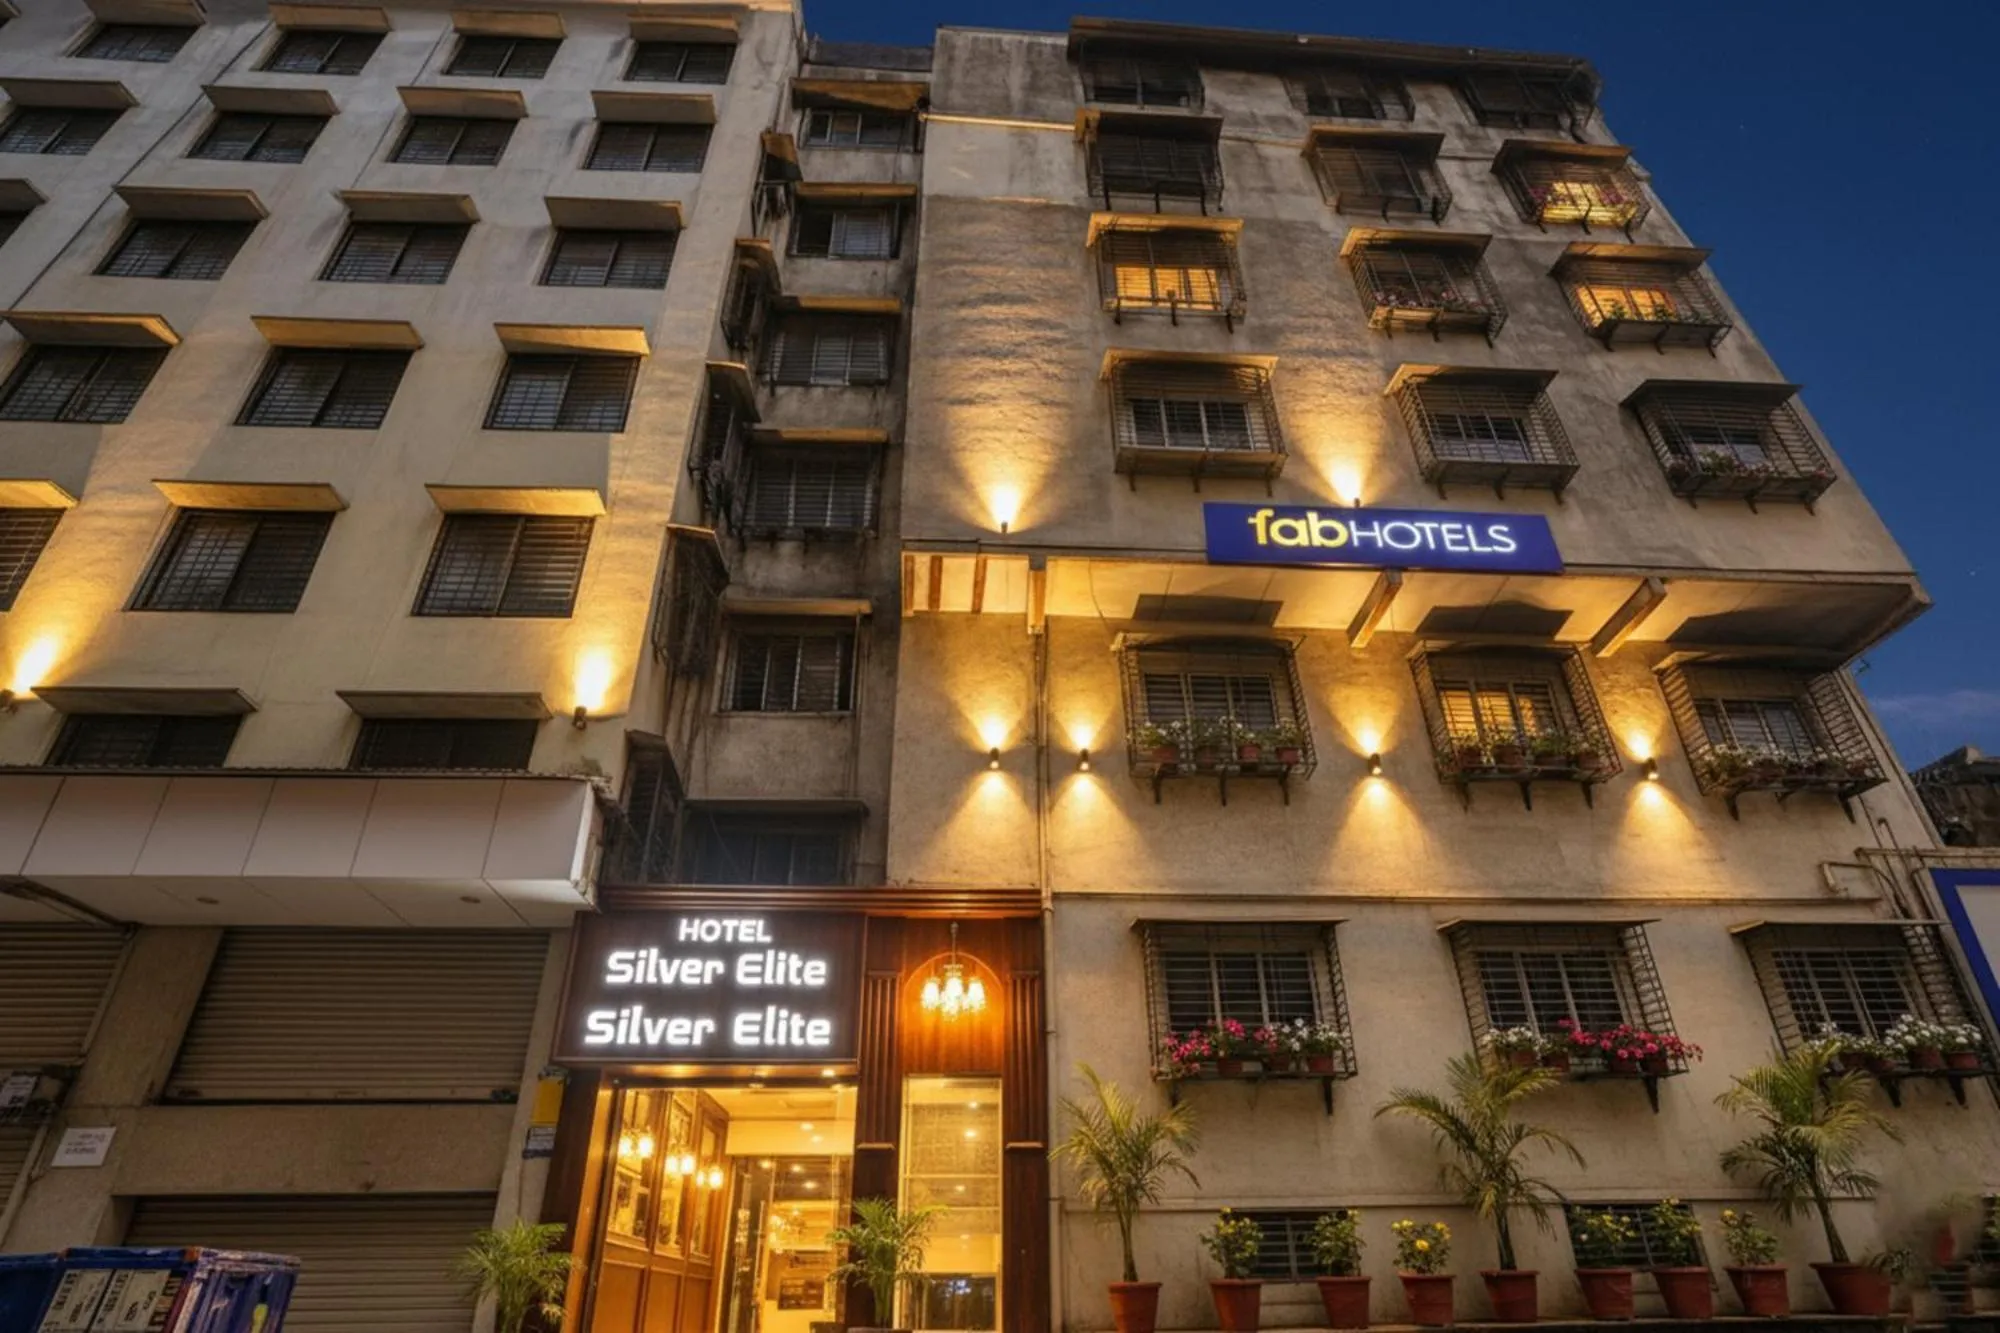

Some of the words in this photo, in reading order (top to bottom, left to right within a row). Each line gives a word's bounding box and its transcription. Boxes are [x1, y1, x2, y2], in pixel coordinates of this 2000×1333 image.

[1248, 508, 1517, 553] fabHOTELS
[678, 918, 773, 942] HOTEL
[605, 948, 725, 985] Silver
[735, 950, 827, 986] Elite
[584, 1005, 715, 1045] Silver
[732, 1006, 831, 1046] Elite
